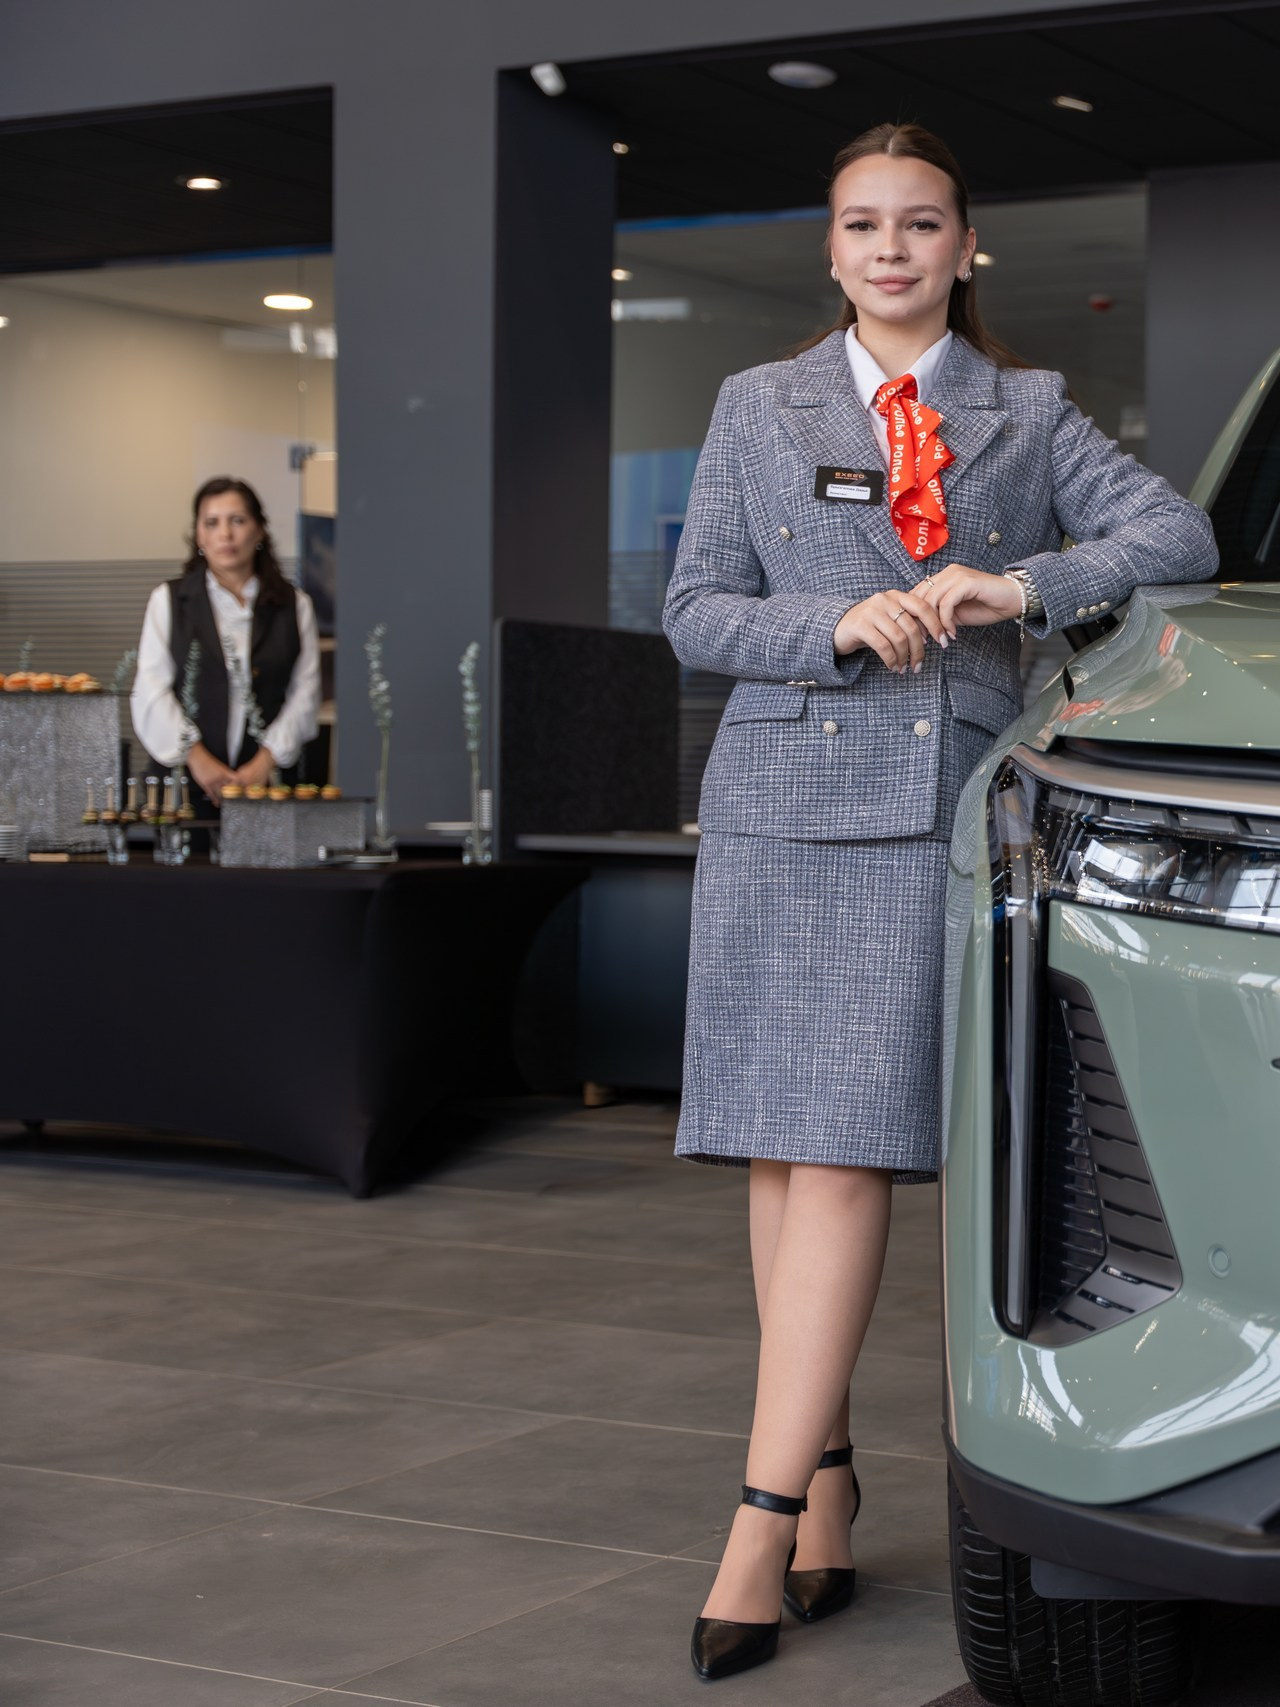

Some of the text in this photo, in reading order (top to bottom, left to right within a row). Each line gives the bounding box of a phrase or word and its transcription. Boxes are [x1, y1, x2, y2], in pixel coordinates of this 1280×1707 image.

[893, 403, 906, 438] РОЛЬФ
[891, 444, 905, 483] РОЛЬФ
[927, 479, 947, 515] ОЛЬФ
[915, 518, 930, 556] РОЛЬ
